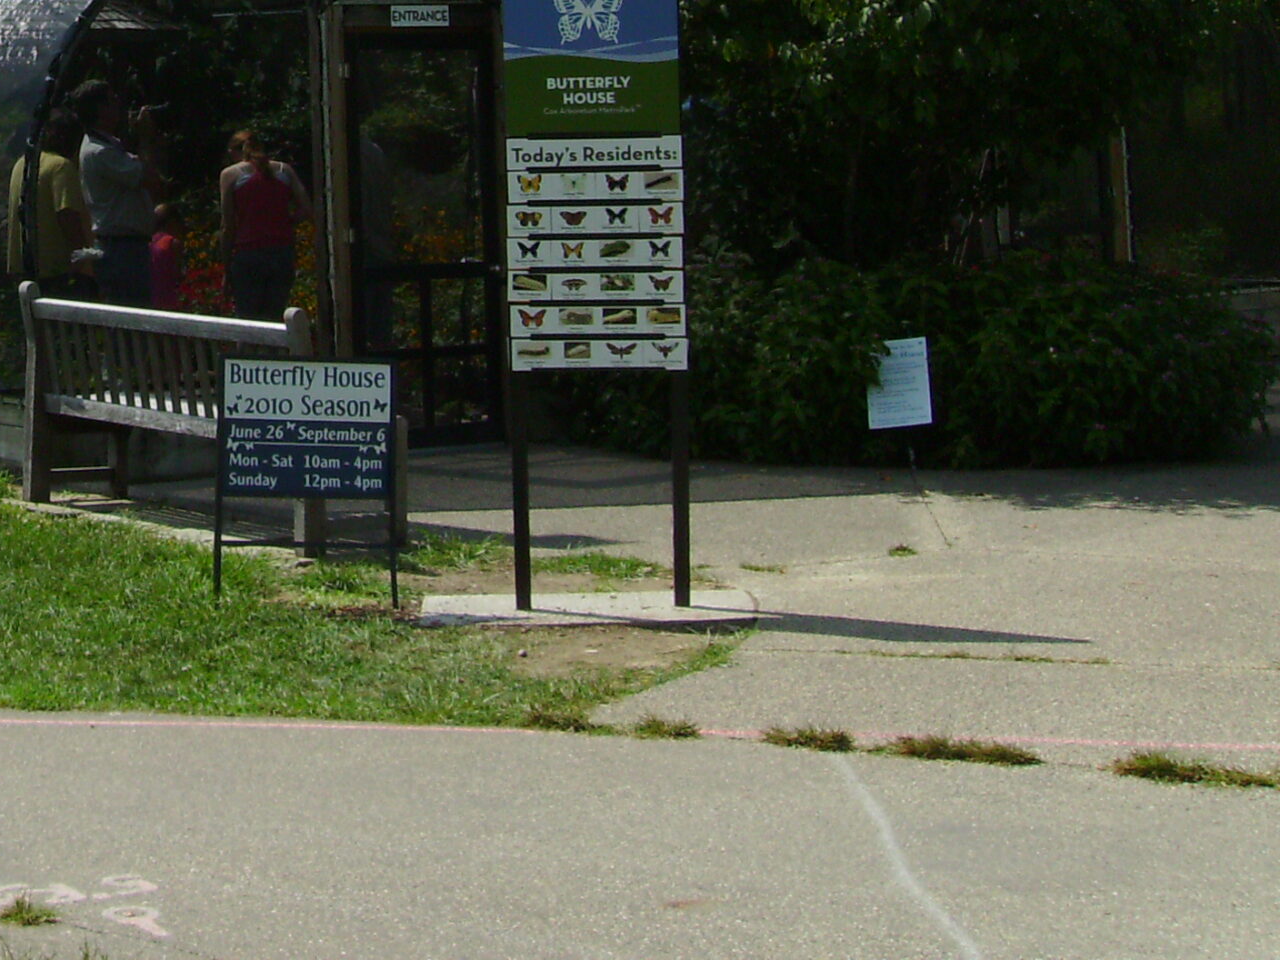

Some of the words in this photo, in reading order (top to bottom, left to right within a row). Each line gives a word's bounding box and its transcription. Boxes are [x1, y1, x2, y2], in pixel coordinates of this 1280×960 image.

[392, 10, 447, 21] ENTRANCE
[546, 76, 631, 90] BUTTERFLY
[563, 92, 616, 105] HOUSE
[511, 146, 577, 167] Today's
[583, 145, 677, 162] Residents:
[230, 363, 316, 390] Butterfly
[324, 367, 385, 388] House
[244, 397, 293, 415] 2010
[301, 395, 371, 417] Season
[230, 424, 261, 439] June
[266, 425, 284, 439] 26
[298, 426, 372, 443] September
[376, 429, 385, 441] 6
[229, 454, 258, 467] Mon
[272, 454, 293, 468] Sat
[304, 455, 340, 469] 10am
[353, 456, 382, 472] 4pm
[229, 472, 278, 489] Sunday
[304, 474, 340, 491] 12pm
[354, 475, 382, 491] 4pm
